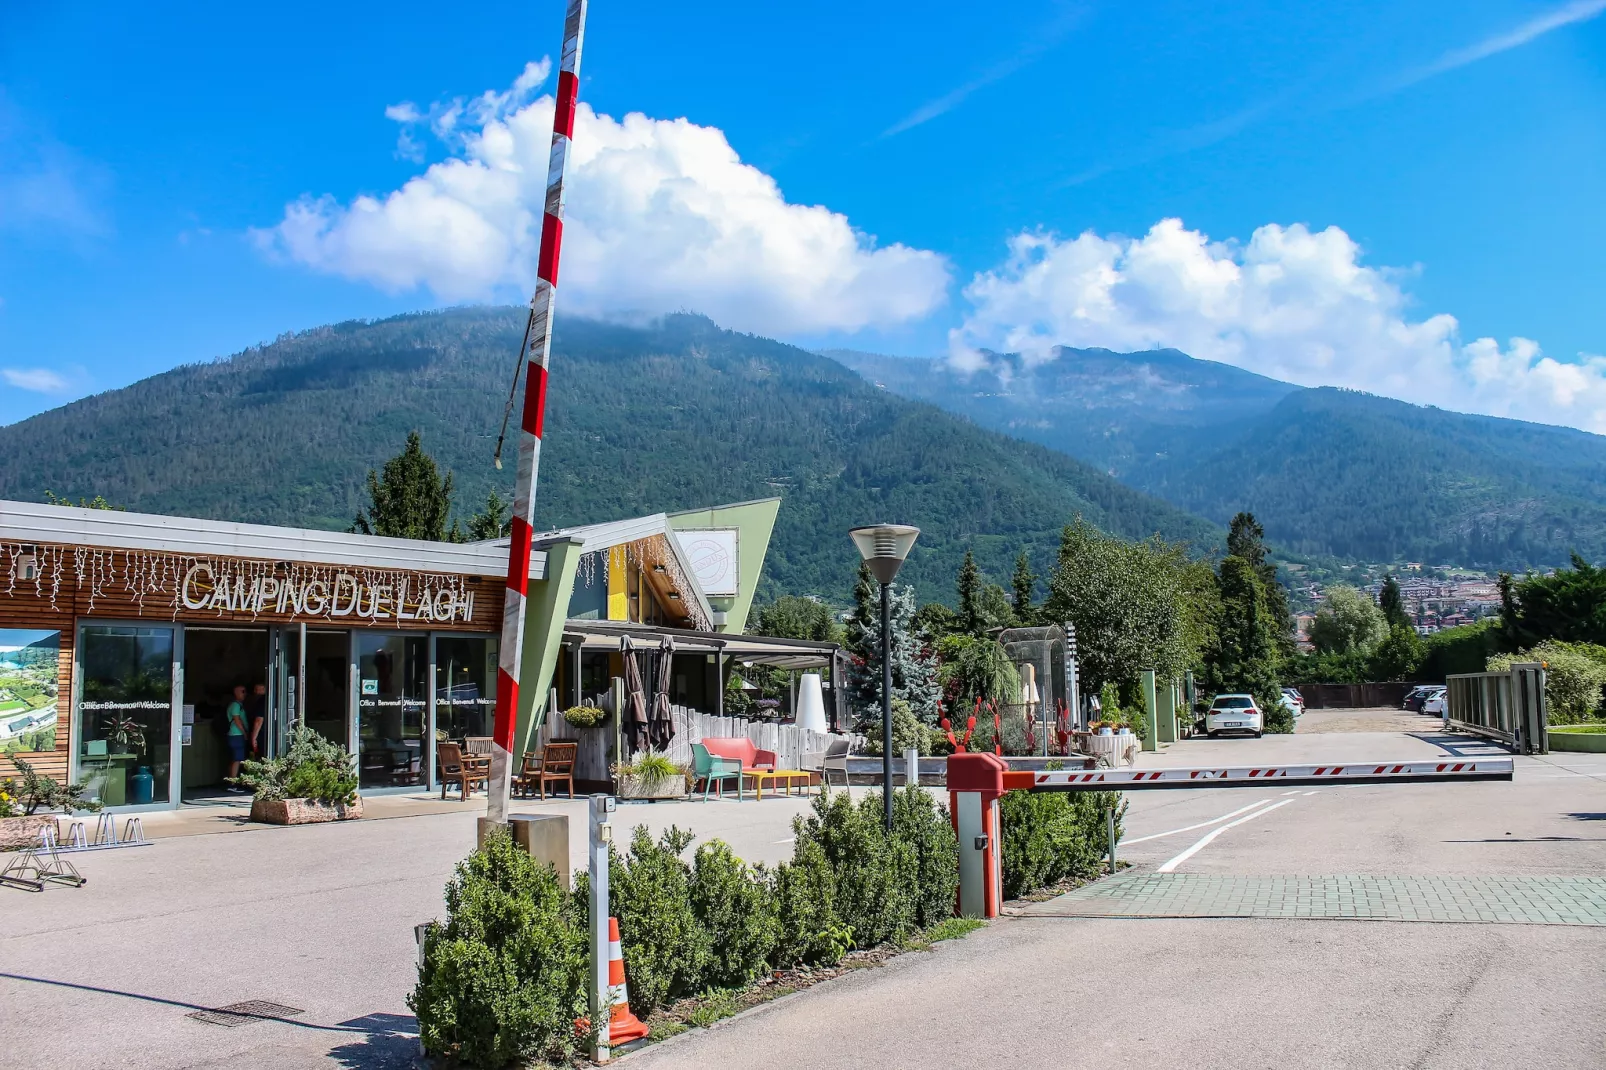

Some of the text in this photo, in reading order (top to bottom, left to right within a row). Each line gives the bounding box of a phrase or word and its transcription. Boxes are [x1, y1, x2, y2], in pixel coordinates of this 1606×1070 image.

[182, 563, 475, 622] CAMPING DUE LAGHI
